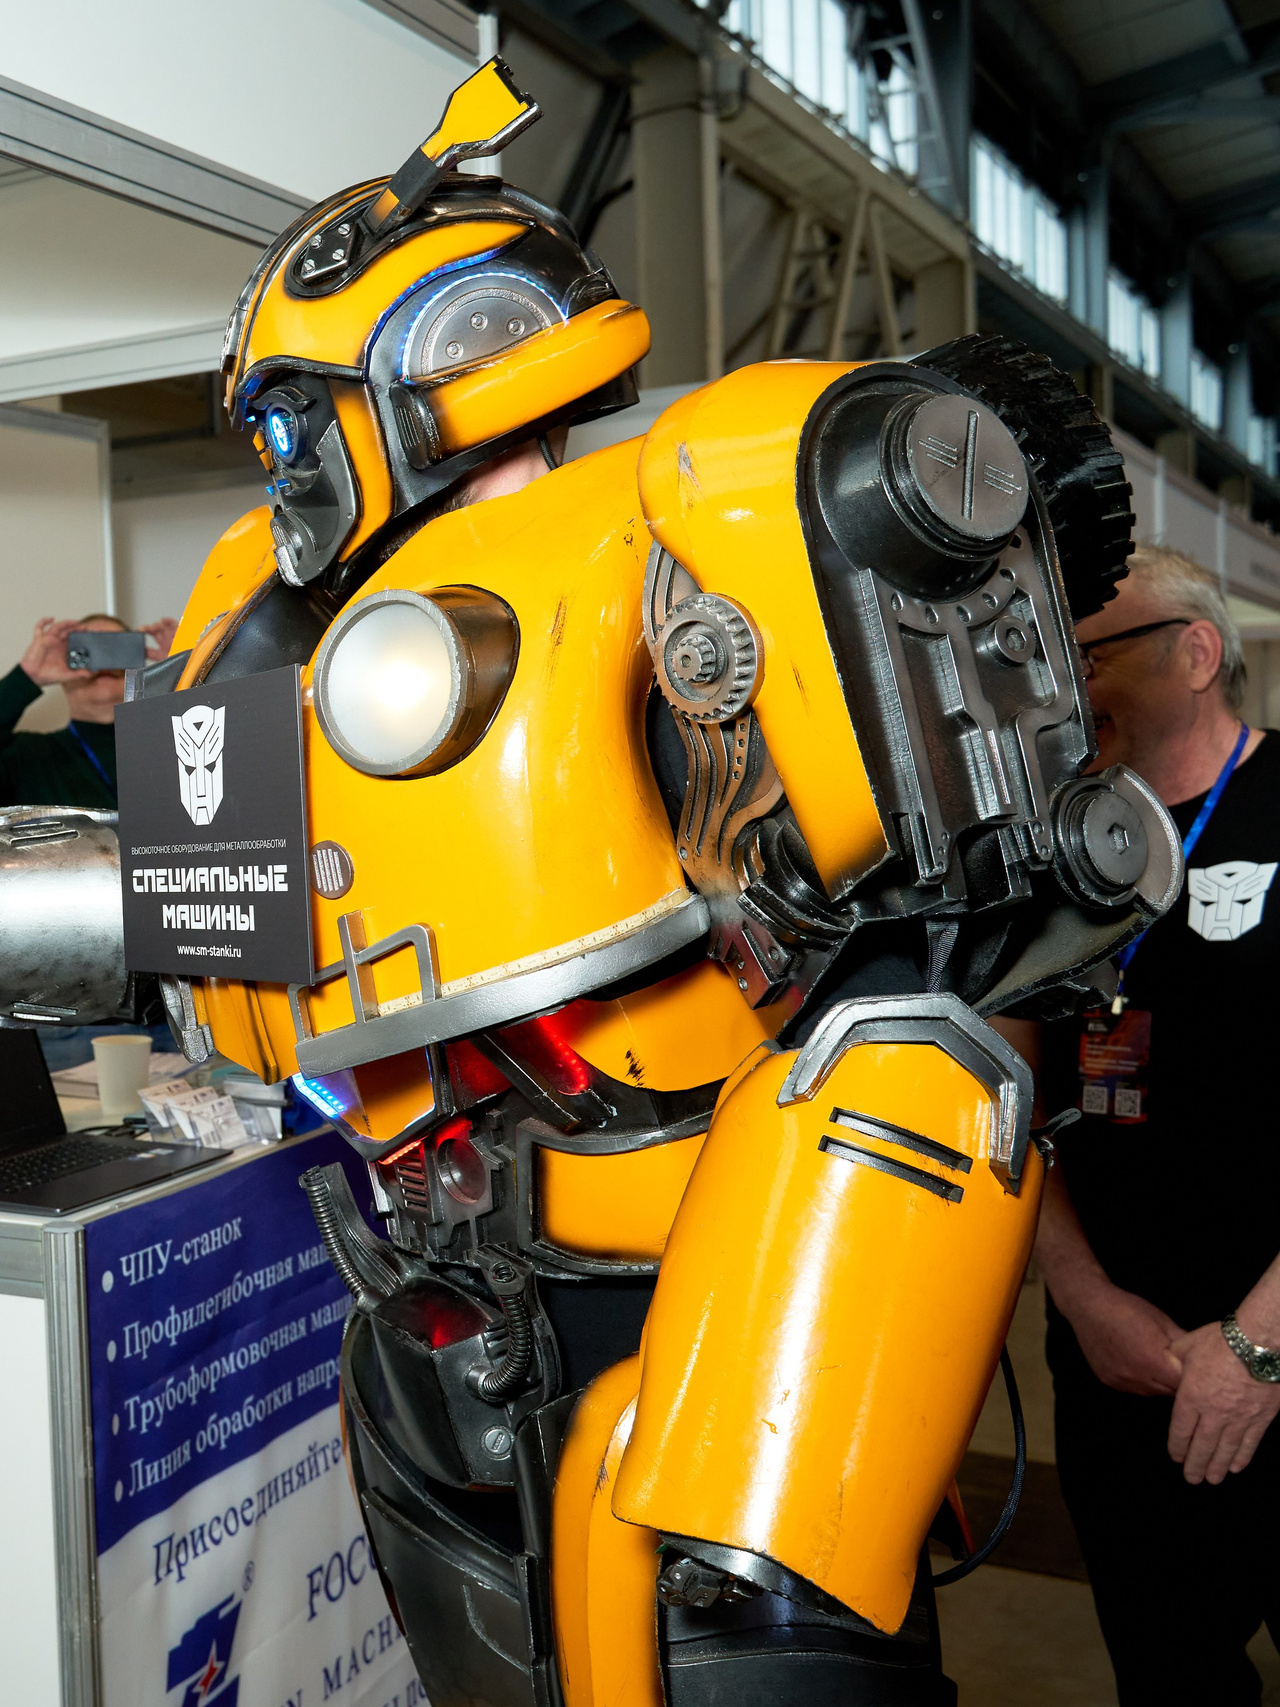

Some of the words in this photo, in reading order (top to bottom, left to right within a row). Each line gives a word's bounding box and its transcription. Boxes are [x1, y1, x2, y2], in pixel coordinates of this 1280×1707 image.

[131, 844, 171, 856] ВЫСОКОТОЧНОЕ
[170, 843, 213, 854] ОБОРУДОВАНИЕ
[213, 842, 226, 853] ДЛЯ
[226, 839, 287, 852] МЕТАЛЛООБРАБОТКИ
[132, 864, 289, 893] СПЕЦИАЛЬНЫЕ
[162, 904, 256, 932] МАШИНЫ
[177, 944, 242, 958] www.sm-stanki.ru
[119, 1216, 242, 1286] ЧПУ-станок
[122, 1256, 293, 1361] Профилегибочная
[124, 1316, 307, 1434] Трубоформовочная
[128, 1438, 191, 1497] Линия
[195, 1381, 293, 1450] обработки
[153, 1438, 343, 1586] Присоединяйте
